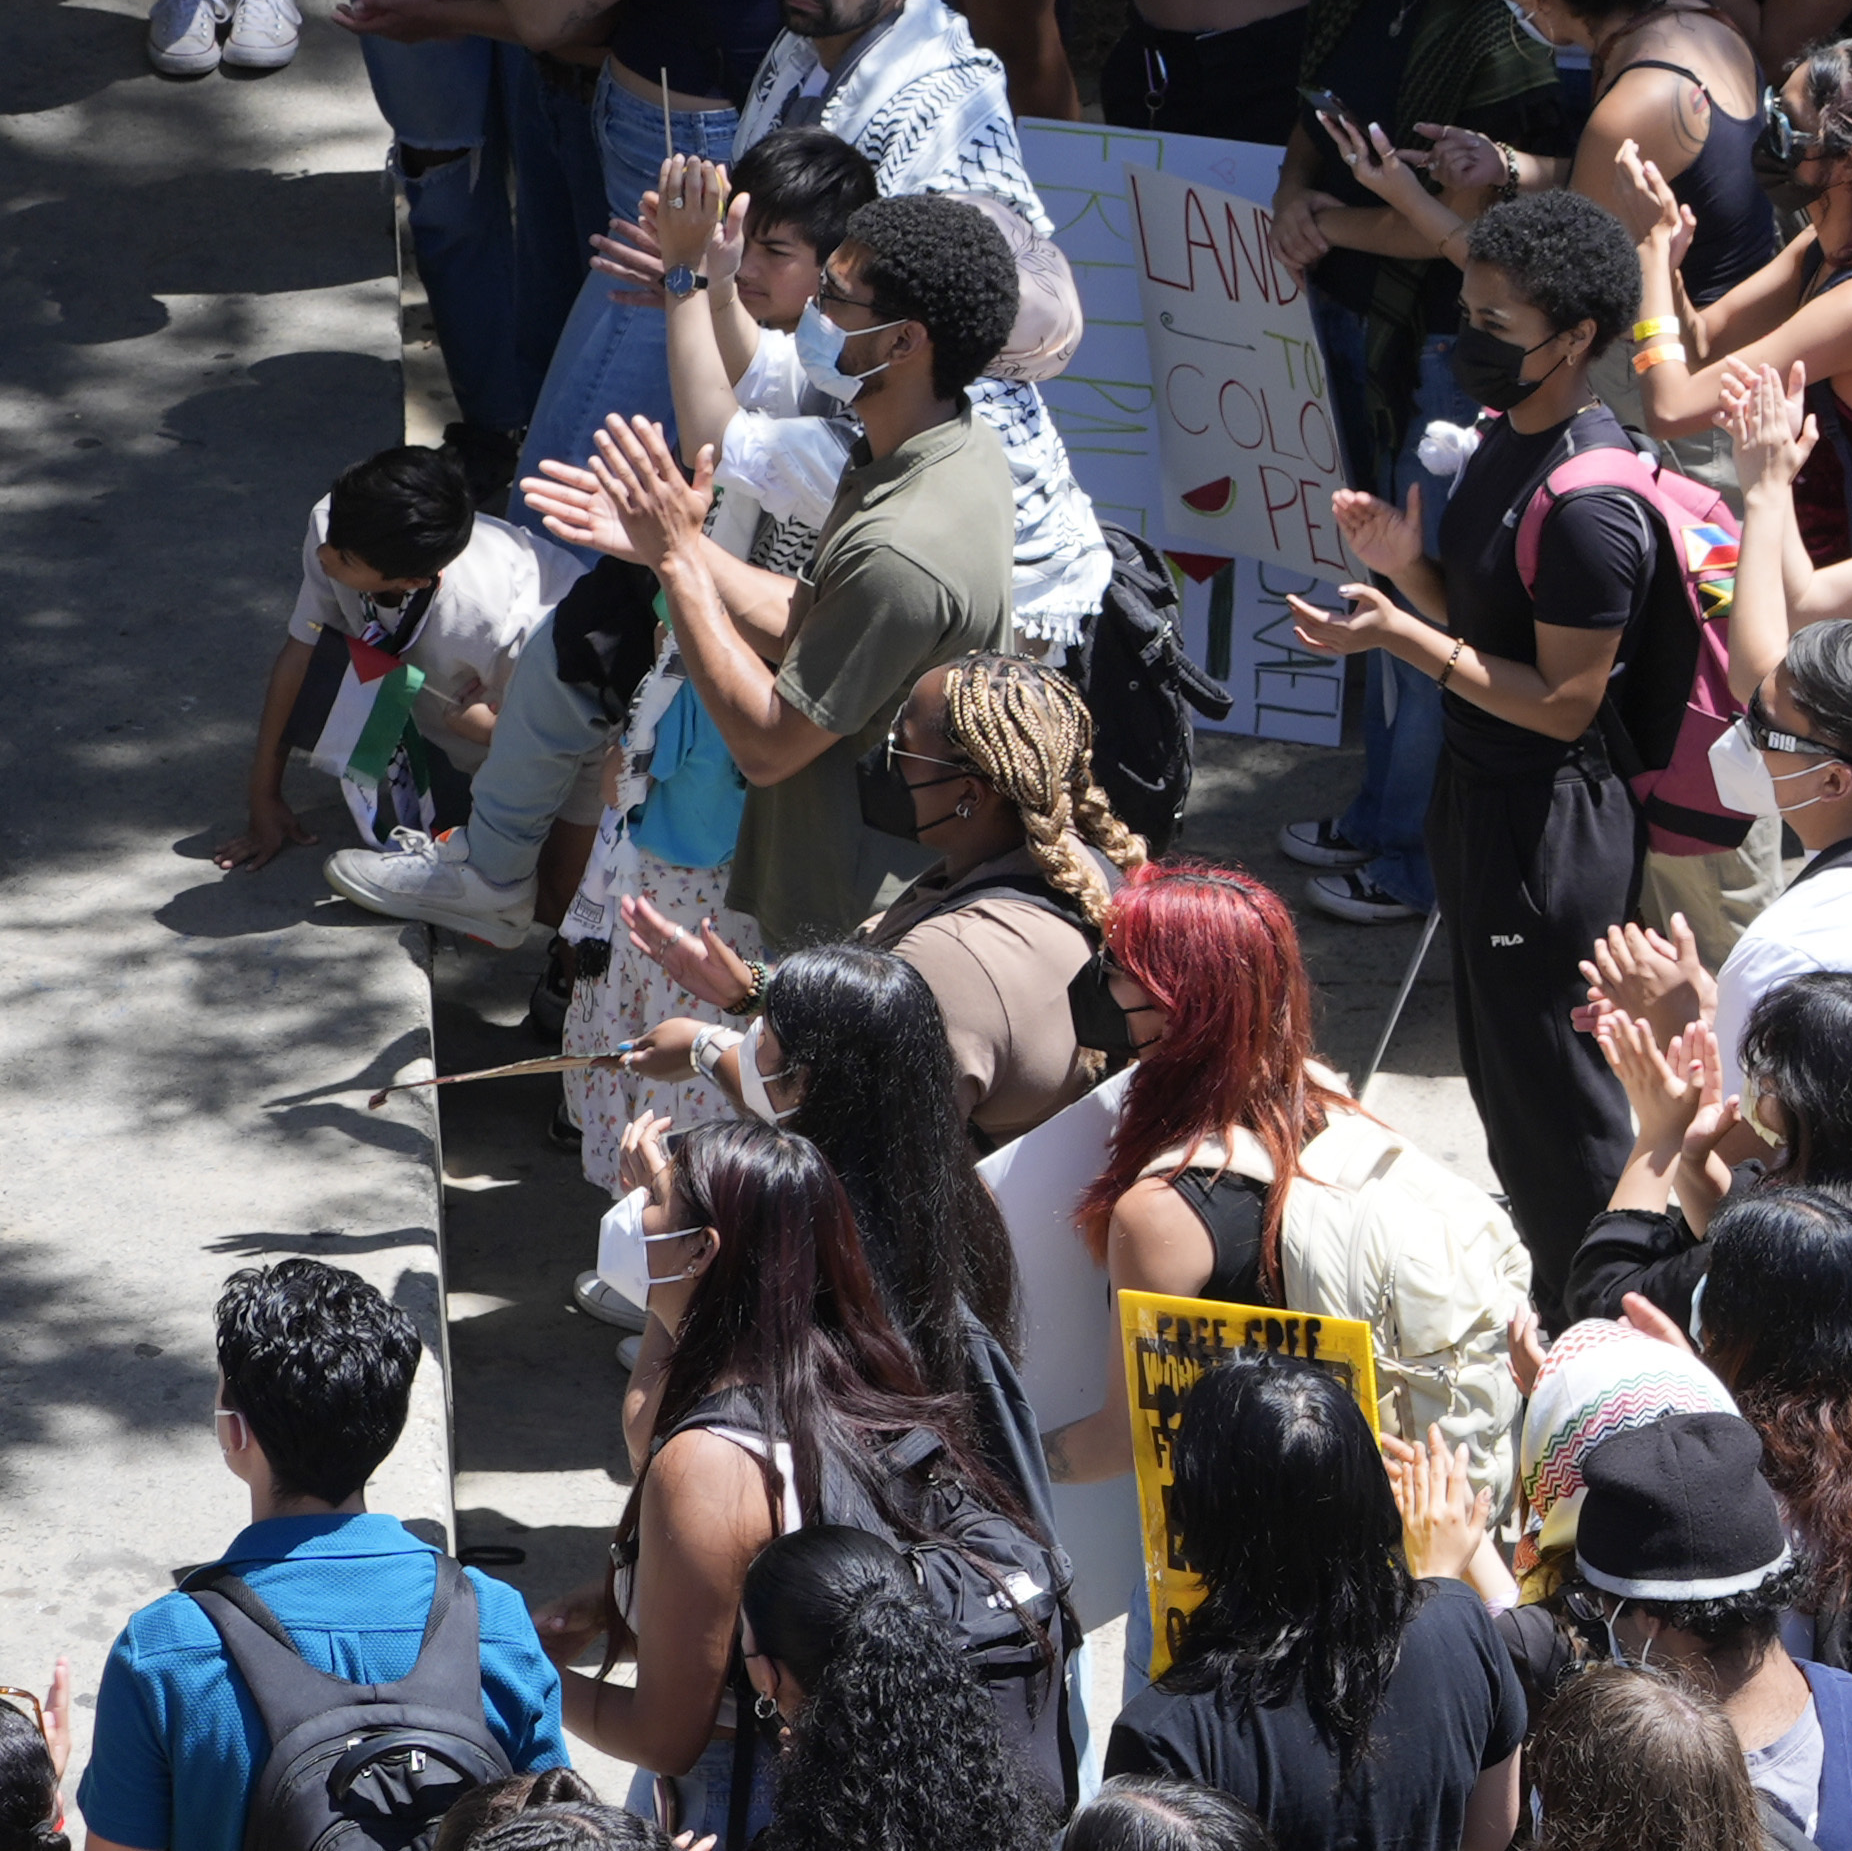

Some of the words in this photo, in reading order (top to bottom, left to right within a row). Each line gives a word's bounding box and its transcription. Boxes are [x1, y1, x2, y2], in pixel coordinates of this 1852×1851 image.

[1263, 330, 1323, 399] TO
[1166, 363, 1343, 481] COLO
[1768, 730, 1797, 753] 619
[1490, 933, 1525, 948] FILA
